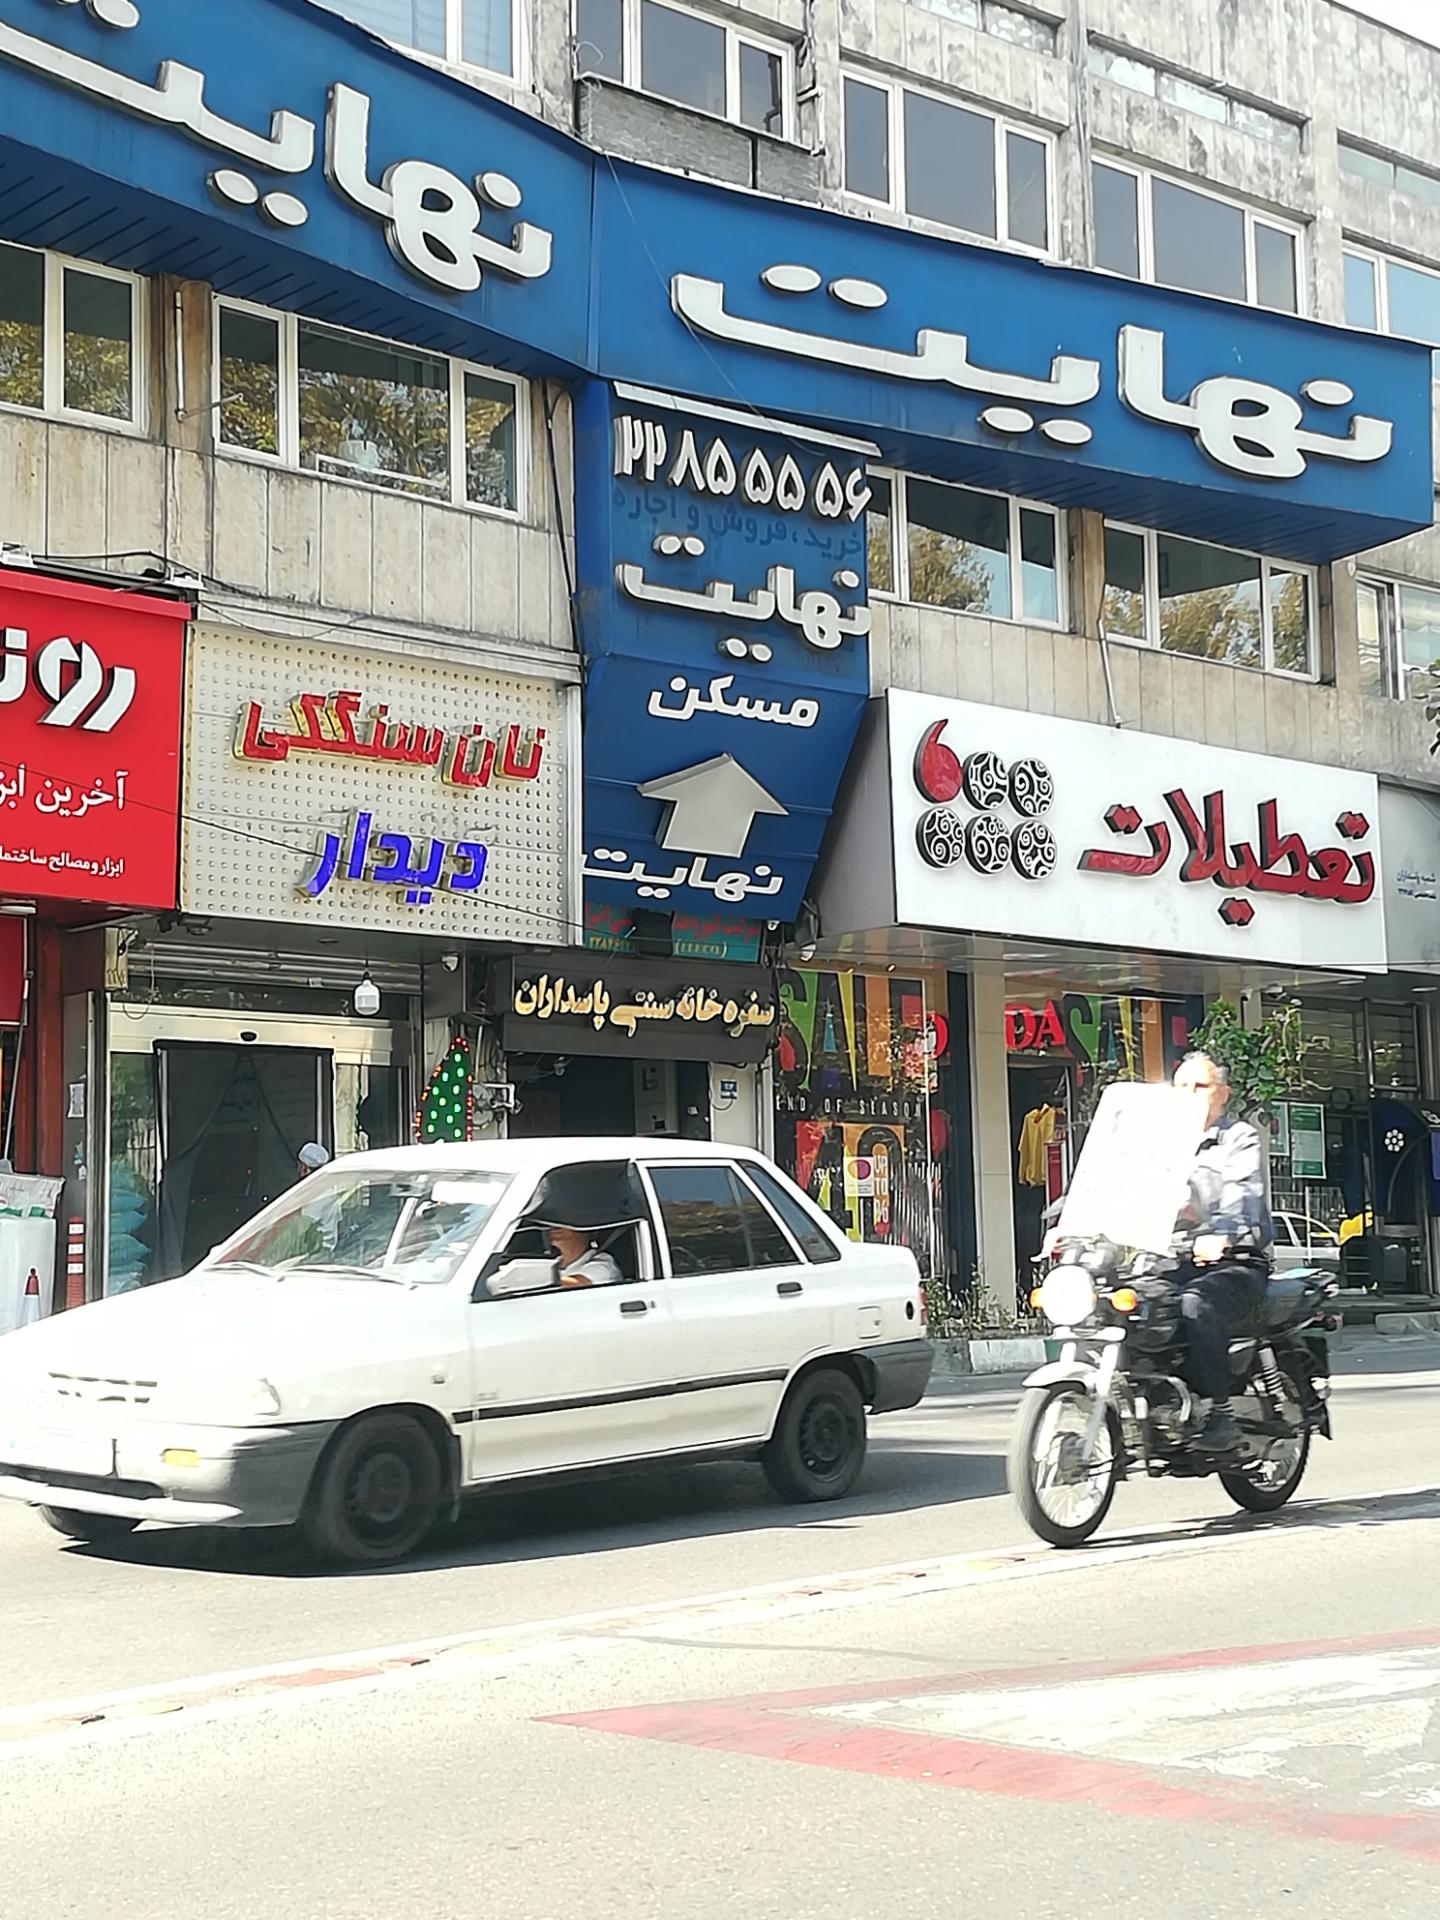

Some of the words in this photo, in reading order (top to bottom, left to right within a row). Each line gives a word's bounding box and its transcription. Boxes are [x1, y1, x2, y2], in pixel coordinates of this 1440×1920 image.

[671, 264, 1393, 479] نهایت
[615, 534, 872, 662] نهایت
[235, 690, 445, 766] سنگکی
[648, 675, 819, 727] مسکن
[445, 724, 546, 788] نان
[35, 770, 129, 817] آخرین
[48, 851, 90, 872] مصالح
[98, 857, 124, 878] ابزار
[297, 811, 488, 905] دیدار
[579, 848, 783, 902] نهایت
[1077, 788, 1376, 928] تعطیلات
[514, 974, 610, 1031] پاسداران
[610, 990, 675, 1037] سنتی
[775, 1094, 806, 1112] END
[824, 1098, 842, 1113] OF
[873, 1154, 888, 1174] UP
